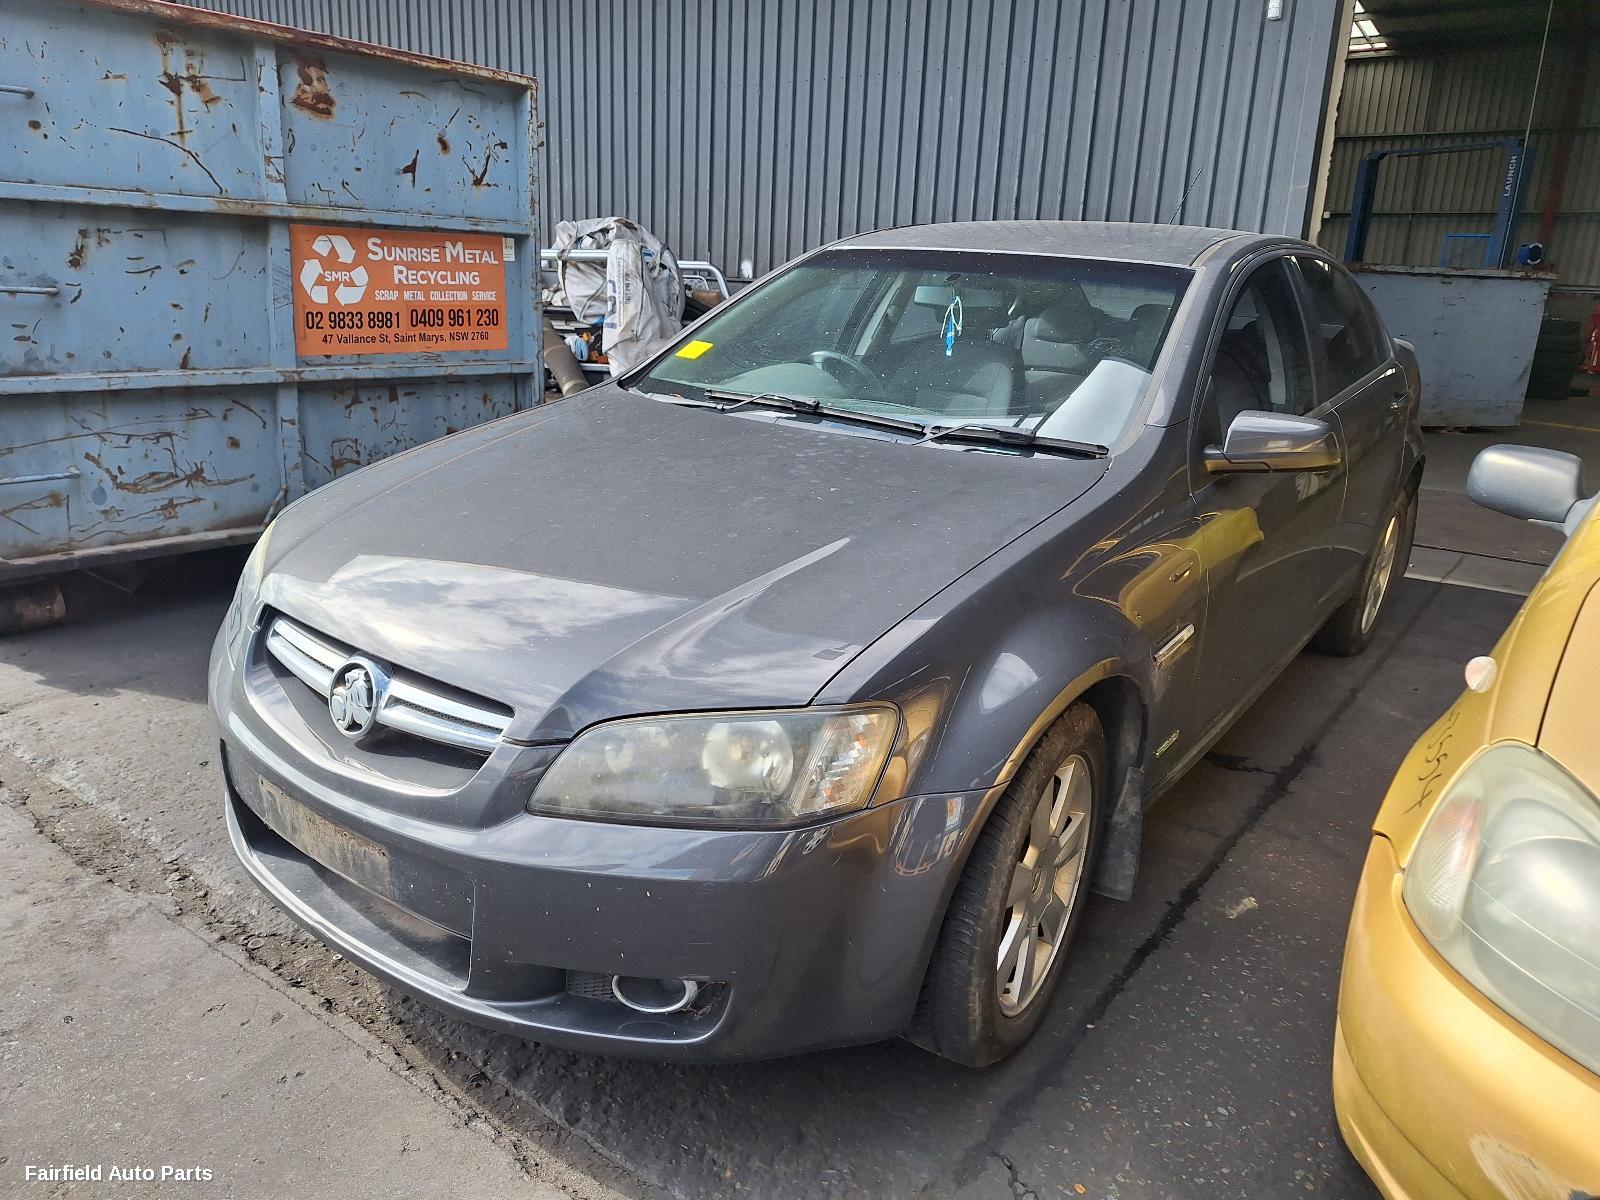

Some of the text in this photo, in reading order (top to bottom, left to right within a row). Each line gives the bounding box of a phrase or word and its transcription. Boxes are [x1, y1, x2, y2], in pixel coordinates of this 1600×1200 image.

[1503, 155, 1518, 197] LAUNCH
[366, 236, 499, 265] SUNRISE METAL
[324, 271, 350, 282] SMR
[393, 264, 481, 285] RECYCLING
[375, 290, 497, 301] SCRAP METAL COLLECTION SERVICE
[305, 311, 400, 330] 02 9833 8981
[410, 308, 499, 328] 0409 961 230
[322, 331, 489, 345] 47 Vallance St, Saint Marys, NSW 2760
